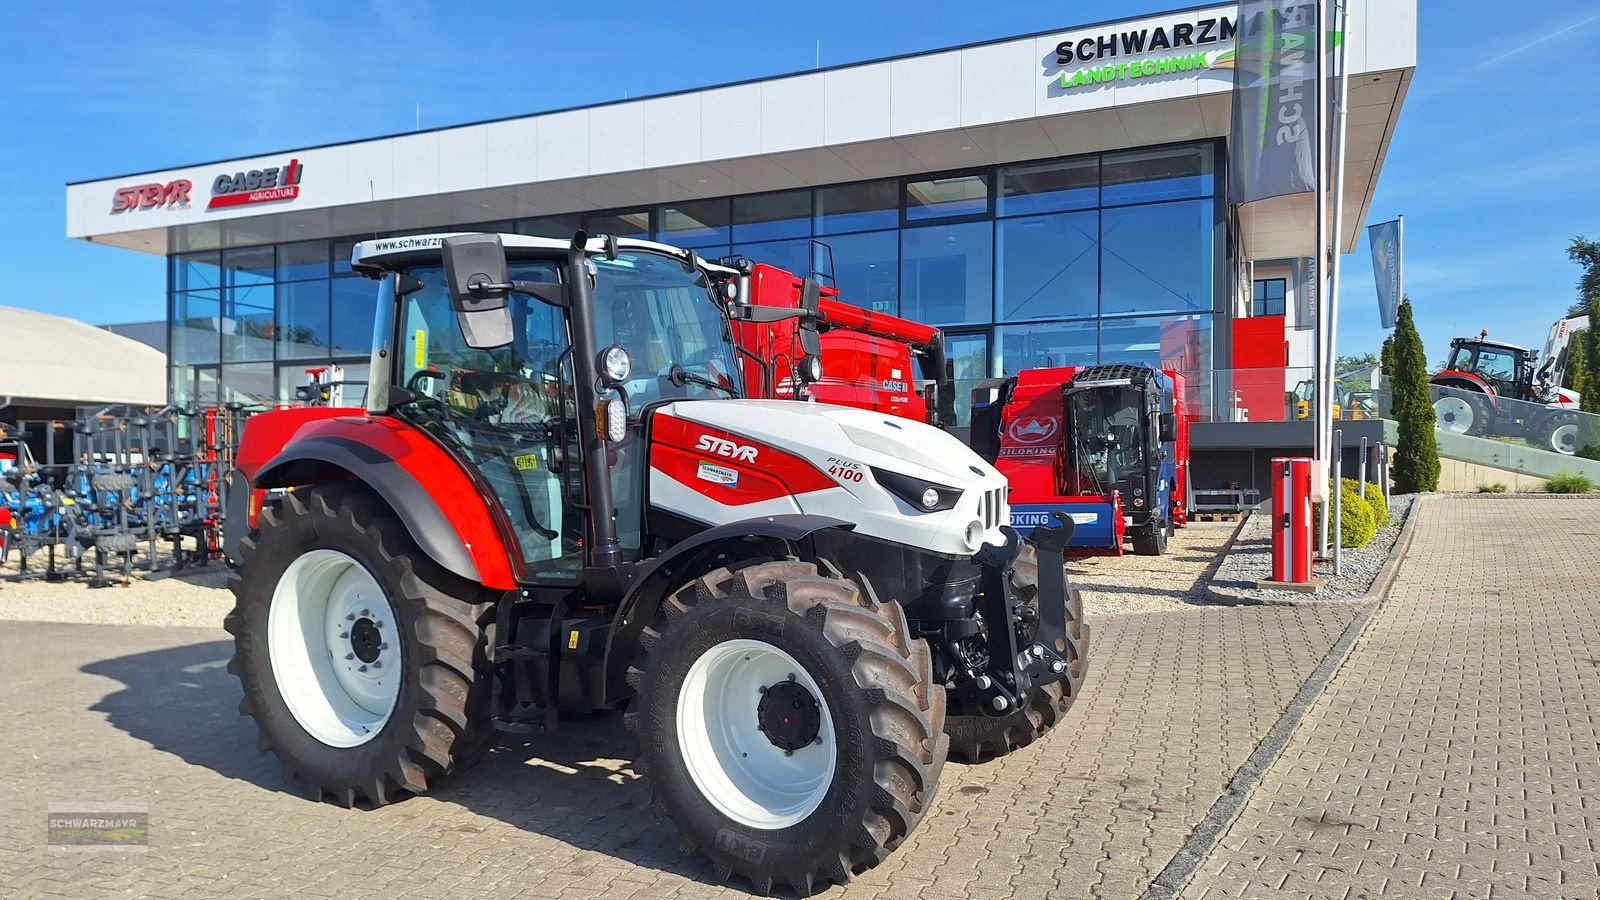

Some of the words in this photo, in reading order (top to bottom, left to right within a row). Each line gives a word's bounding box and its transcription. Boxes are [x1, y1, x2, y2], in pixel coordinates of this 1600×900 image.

[1060, 51, 1208, 89] LANDTECHNIK
[214, 167, 279, 194] CASE
[113, 179, 192, 211] STEYR
[249, 188, 295, 201] AGRICULTURE
[883, 379, 902, 392] CASE
[695, 434, 758, 464] STEYR
[999, 447, 1057, 455] SILOKING
[827, 457, 860, 470] PLUS
[828, 465, 863, 483] 4100
